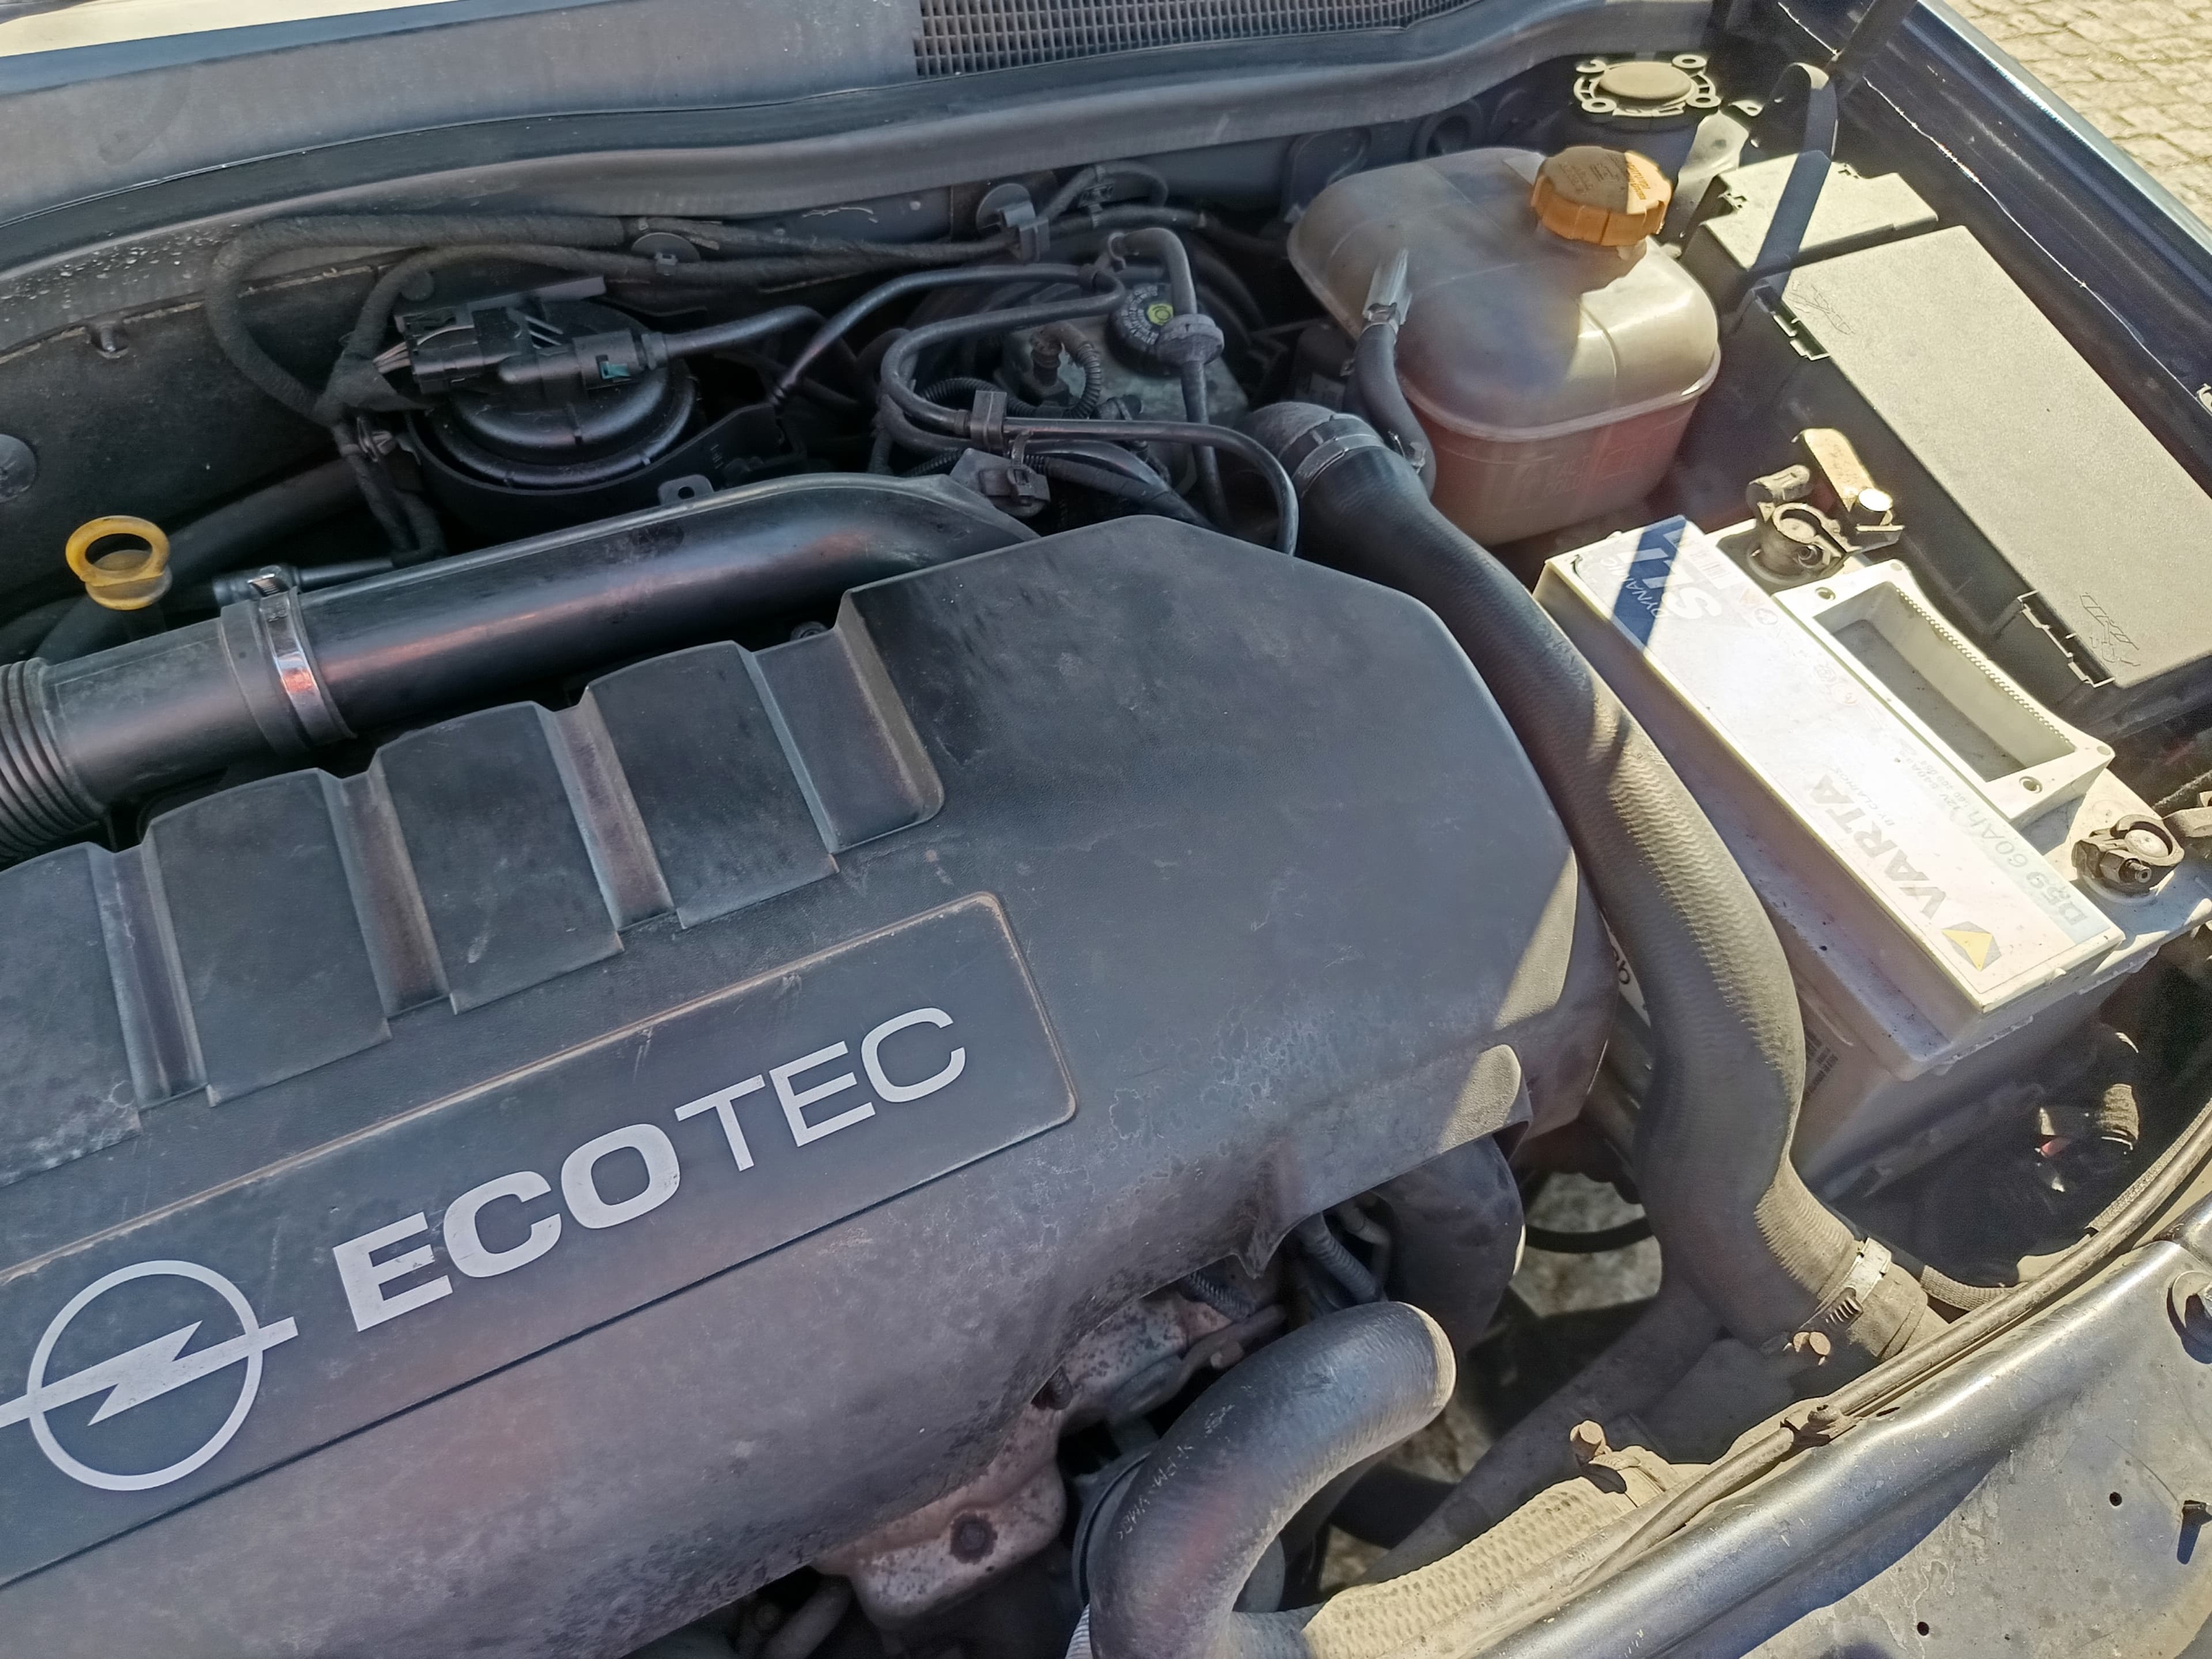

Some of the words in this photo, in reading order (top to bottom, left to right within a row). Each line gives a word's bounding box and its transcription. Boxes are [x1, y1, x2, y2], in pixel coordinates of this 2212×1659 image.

[1600, 558, 1671, 618] DYNAMIC
[1618, 548, 1722, 619] SLI
[1809, 774, 1946, 920] VARTA
[1968, 811, 2028, 868] 60Ah
[2027, 872, 2088, 926] D59
[334, 1007, 966, 1332] ECOTEC
